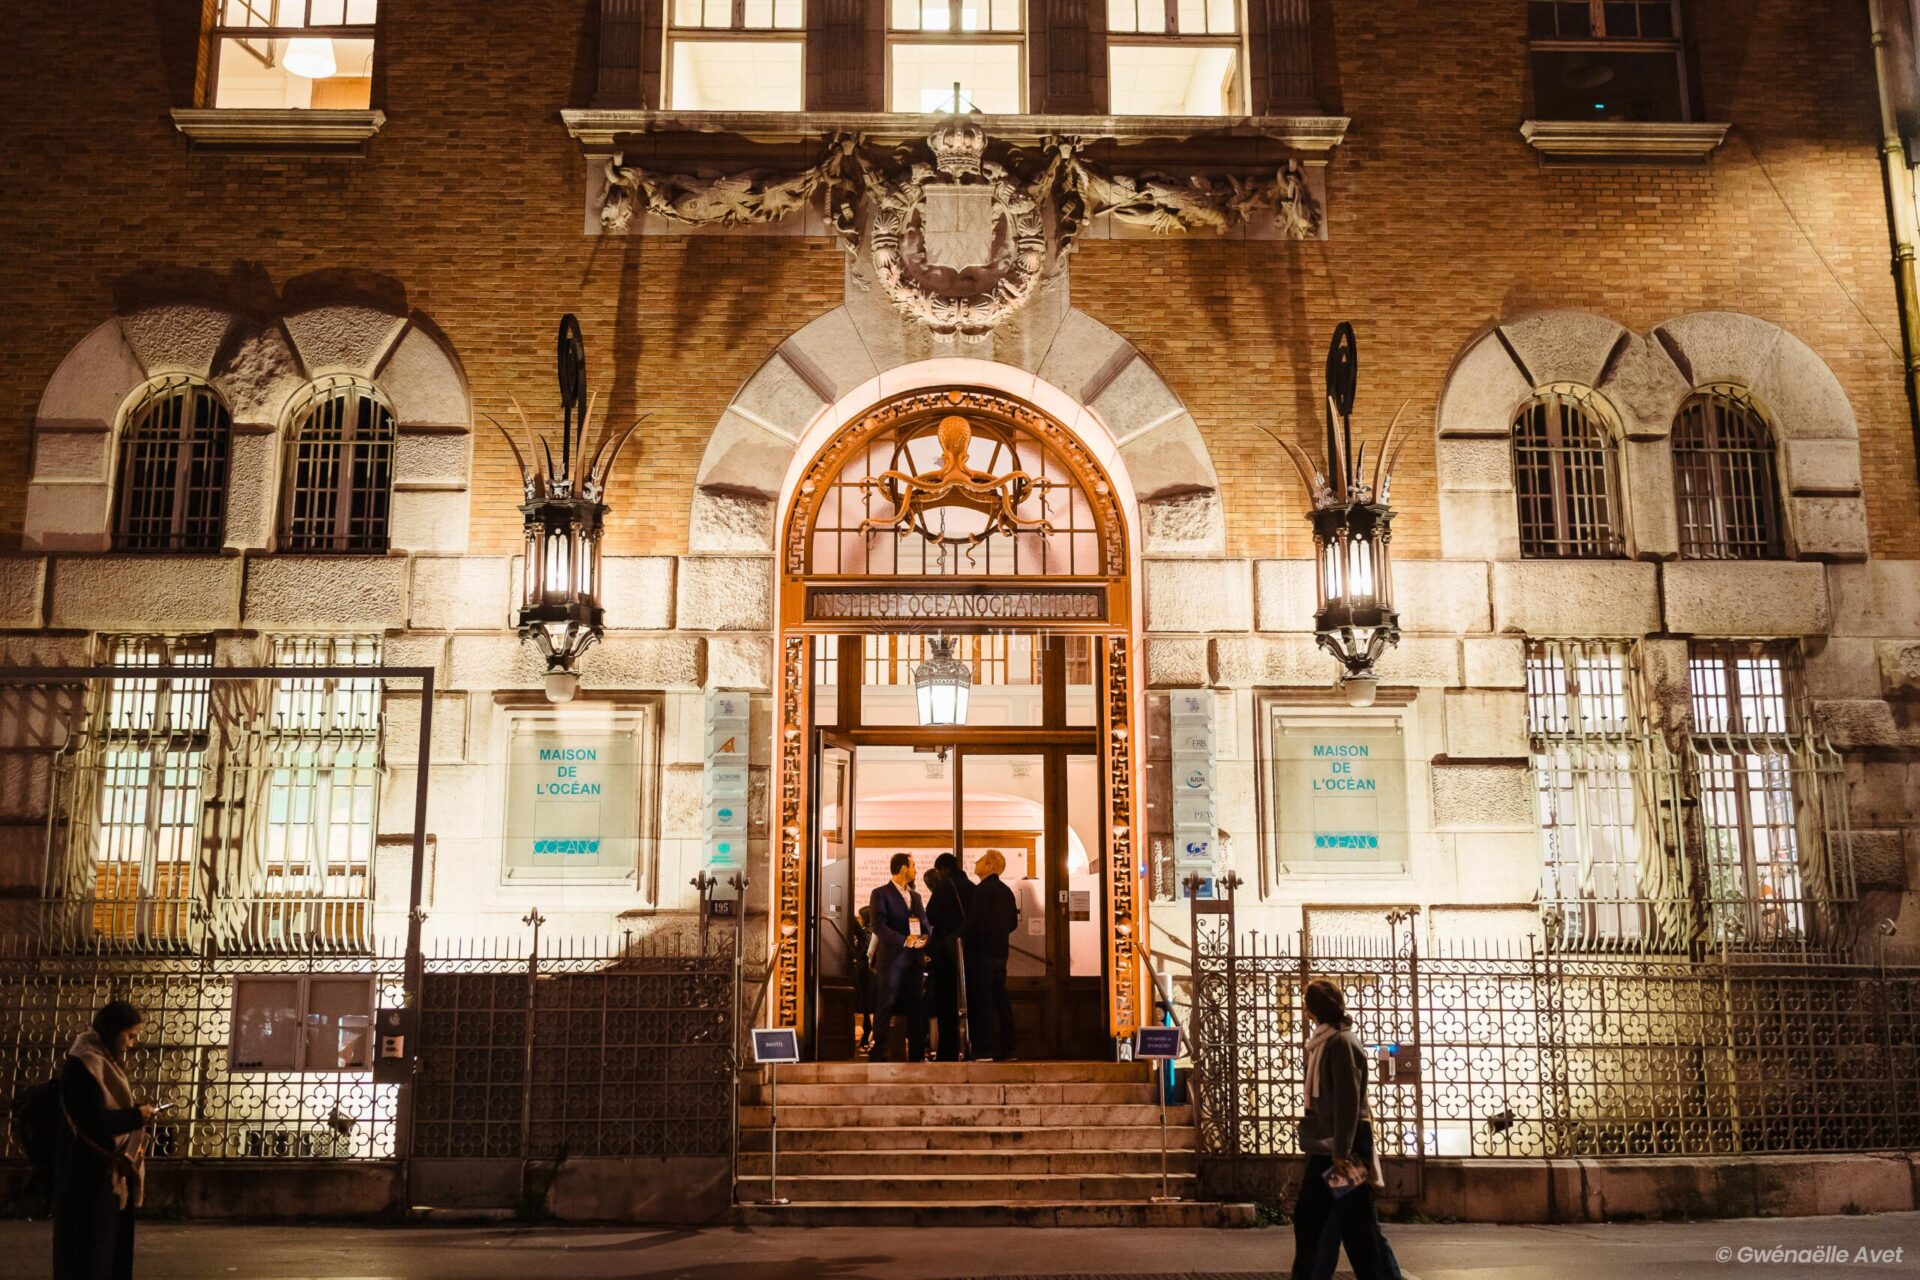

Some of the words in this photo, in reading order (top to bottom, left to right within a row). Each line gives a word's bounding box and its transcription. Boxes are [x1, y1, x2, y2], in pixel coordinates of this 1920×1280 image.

[814, 593, 903, 614] INSTITUT
[908, 593, 1095, 614] OCEANOGRAPHIQUE
[540, 749, 596, 760] MAISON
[1313, 745, 1369, 756] MAISON
[557, 766, 577, 777] DE
[1332, 762, 1351, 773] DE
[536, 780, 601, 795] L'OCÉAN
[1313, 776, 1376, 790] L'OCÉAN
[533, 840, 600, 854] OCEANO
[1314, 835, 1379, 849] OCEANO
[714, 902, 729, 913] 195
